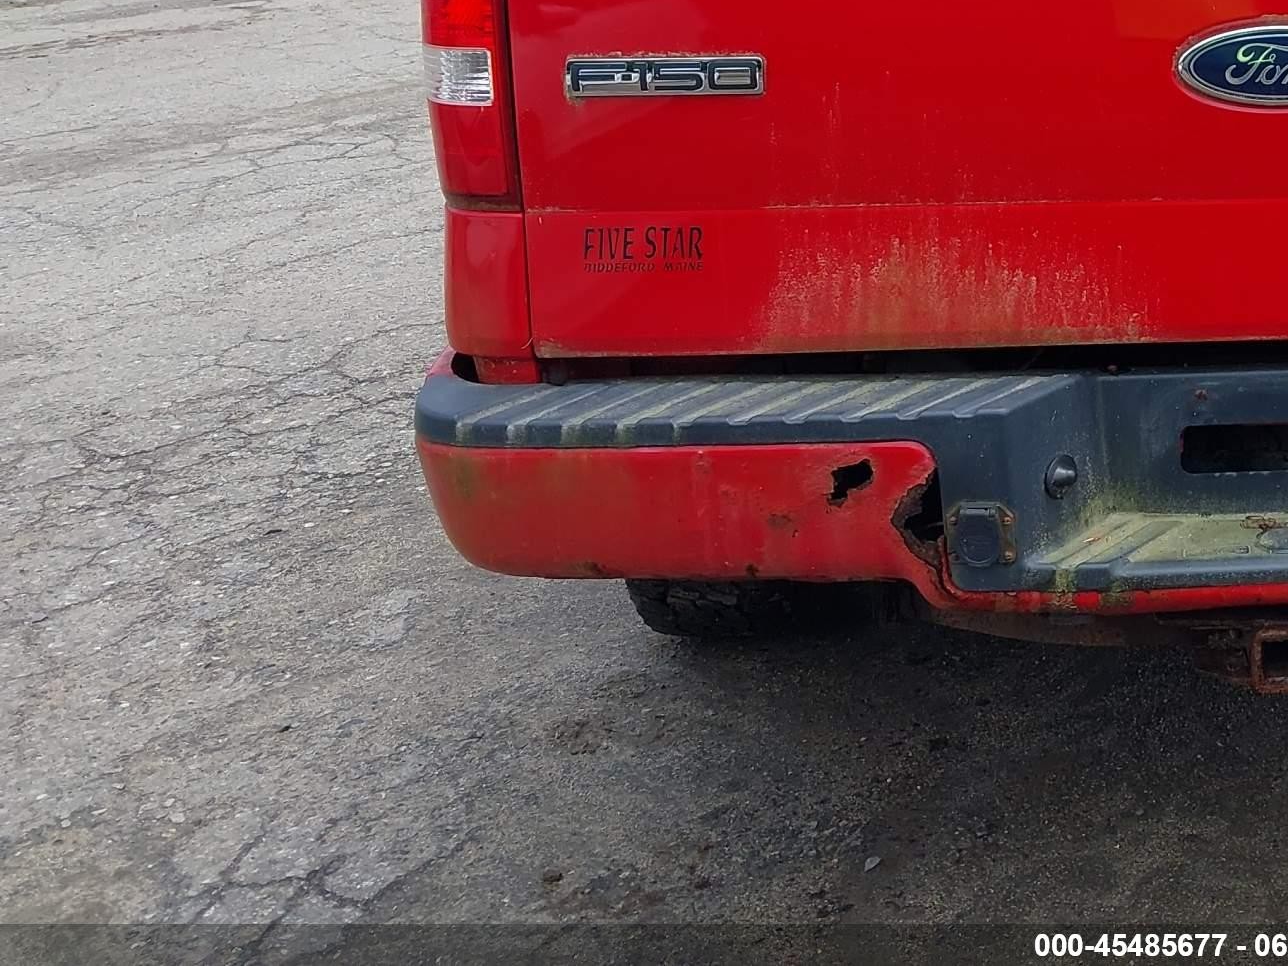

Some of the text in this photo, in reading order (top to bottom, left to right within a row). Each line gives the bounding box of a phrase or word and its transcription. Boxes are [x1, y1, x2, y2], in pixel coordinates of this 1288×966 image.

[569, 60, 759, 92] F-150
[583, 225, 704, 261] FIVE STAR
